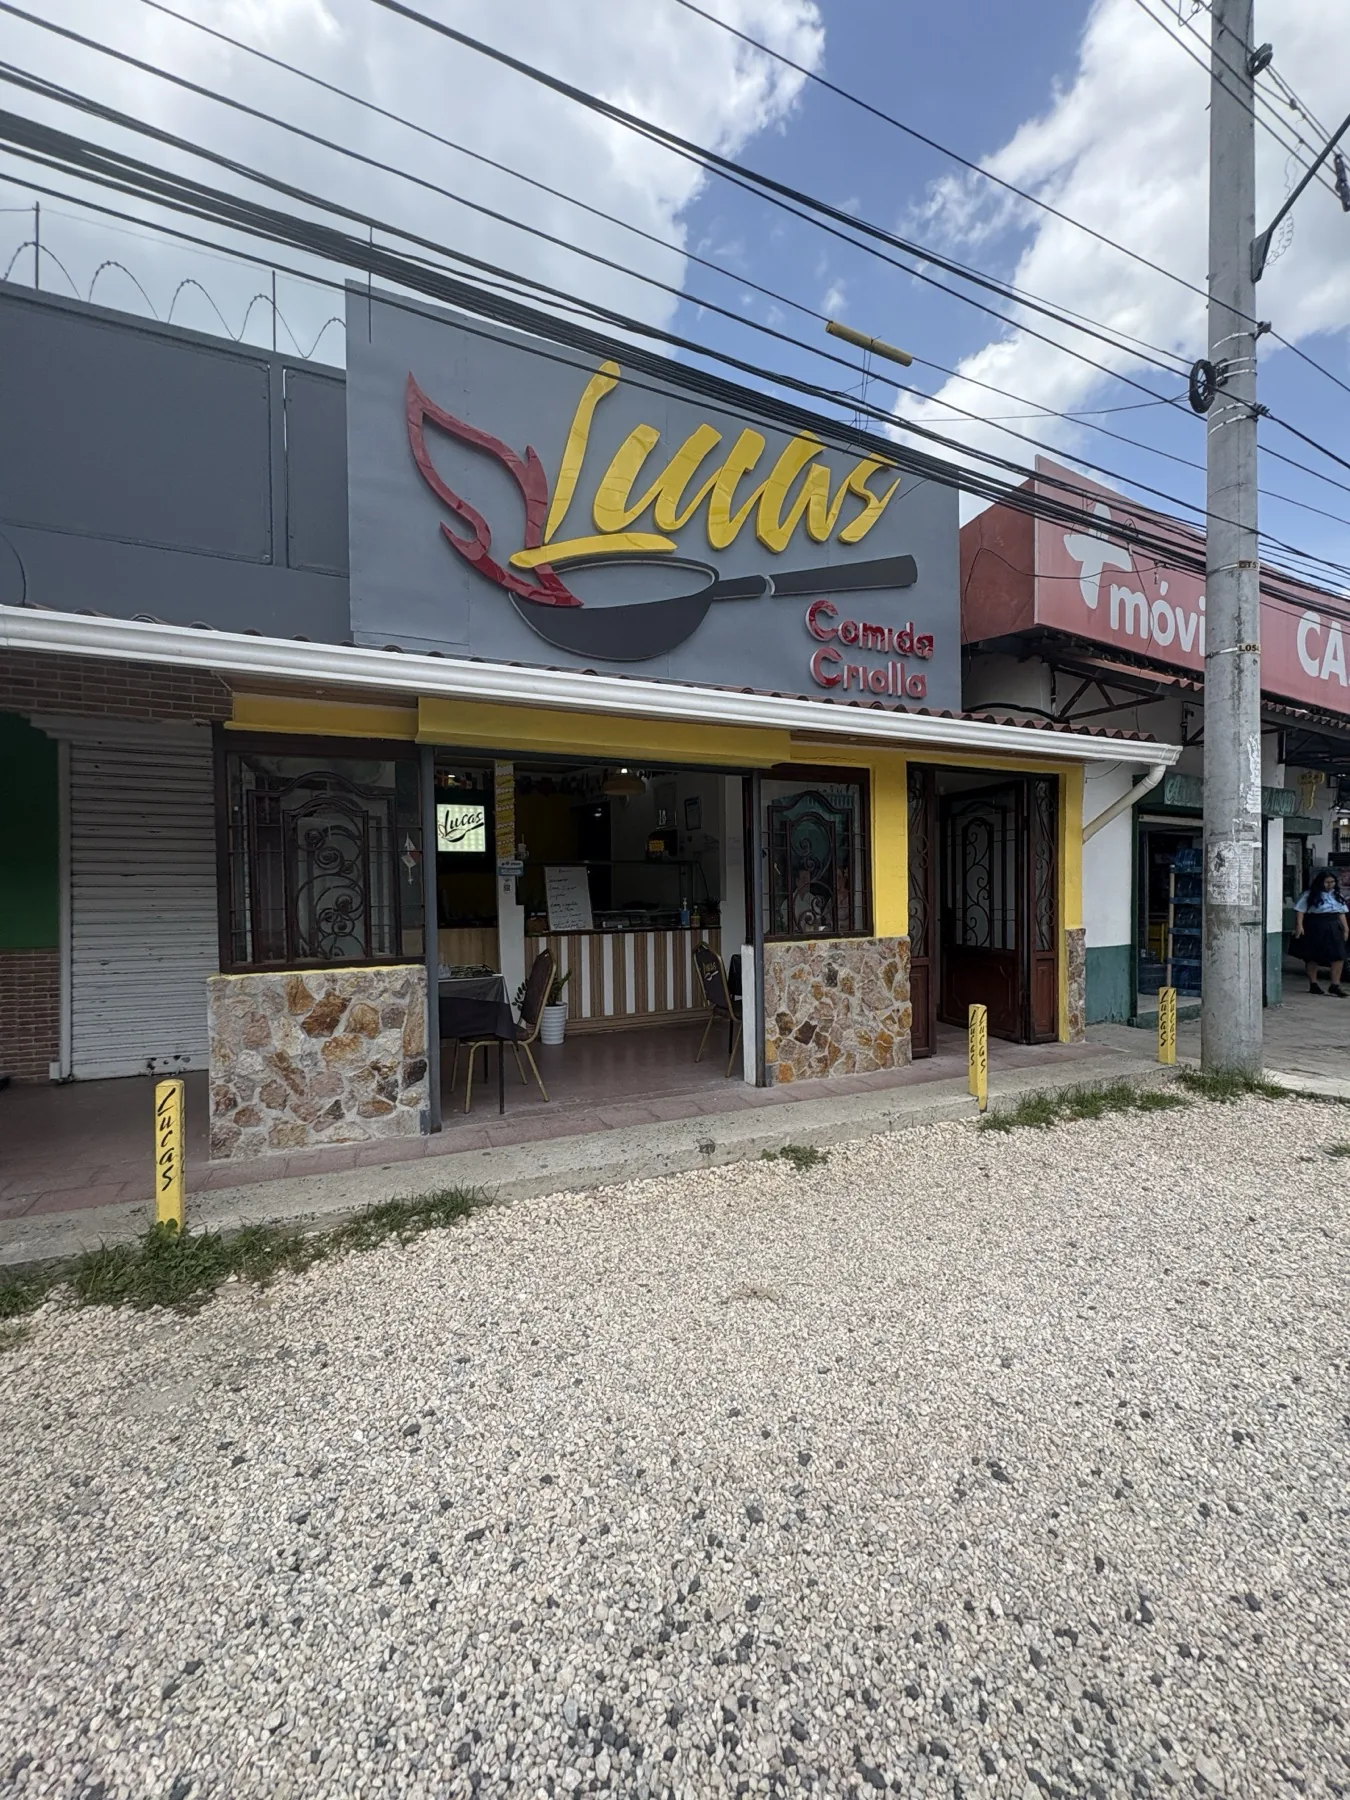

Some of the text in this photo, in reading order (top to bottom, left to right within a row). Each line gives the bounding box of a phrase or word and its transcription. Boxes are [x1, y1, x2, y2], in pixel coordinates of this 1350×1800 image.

[510, 360, 900, 568] Lucas
[805, 599, 934, 659] Comida
[1110, 580, 1350, 687] móvi CA
[810, 646, 927, 698] Criolla
[445, 809, 483, 837] Lucas
[157, 1087, 177, 1192] Lucas
